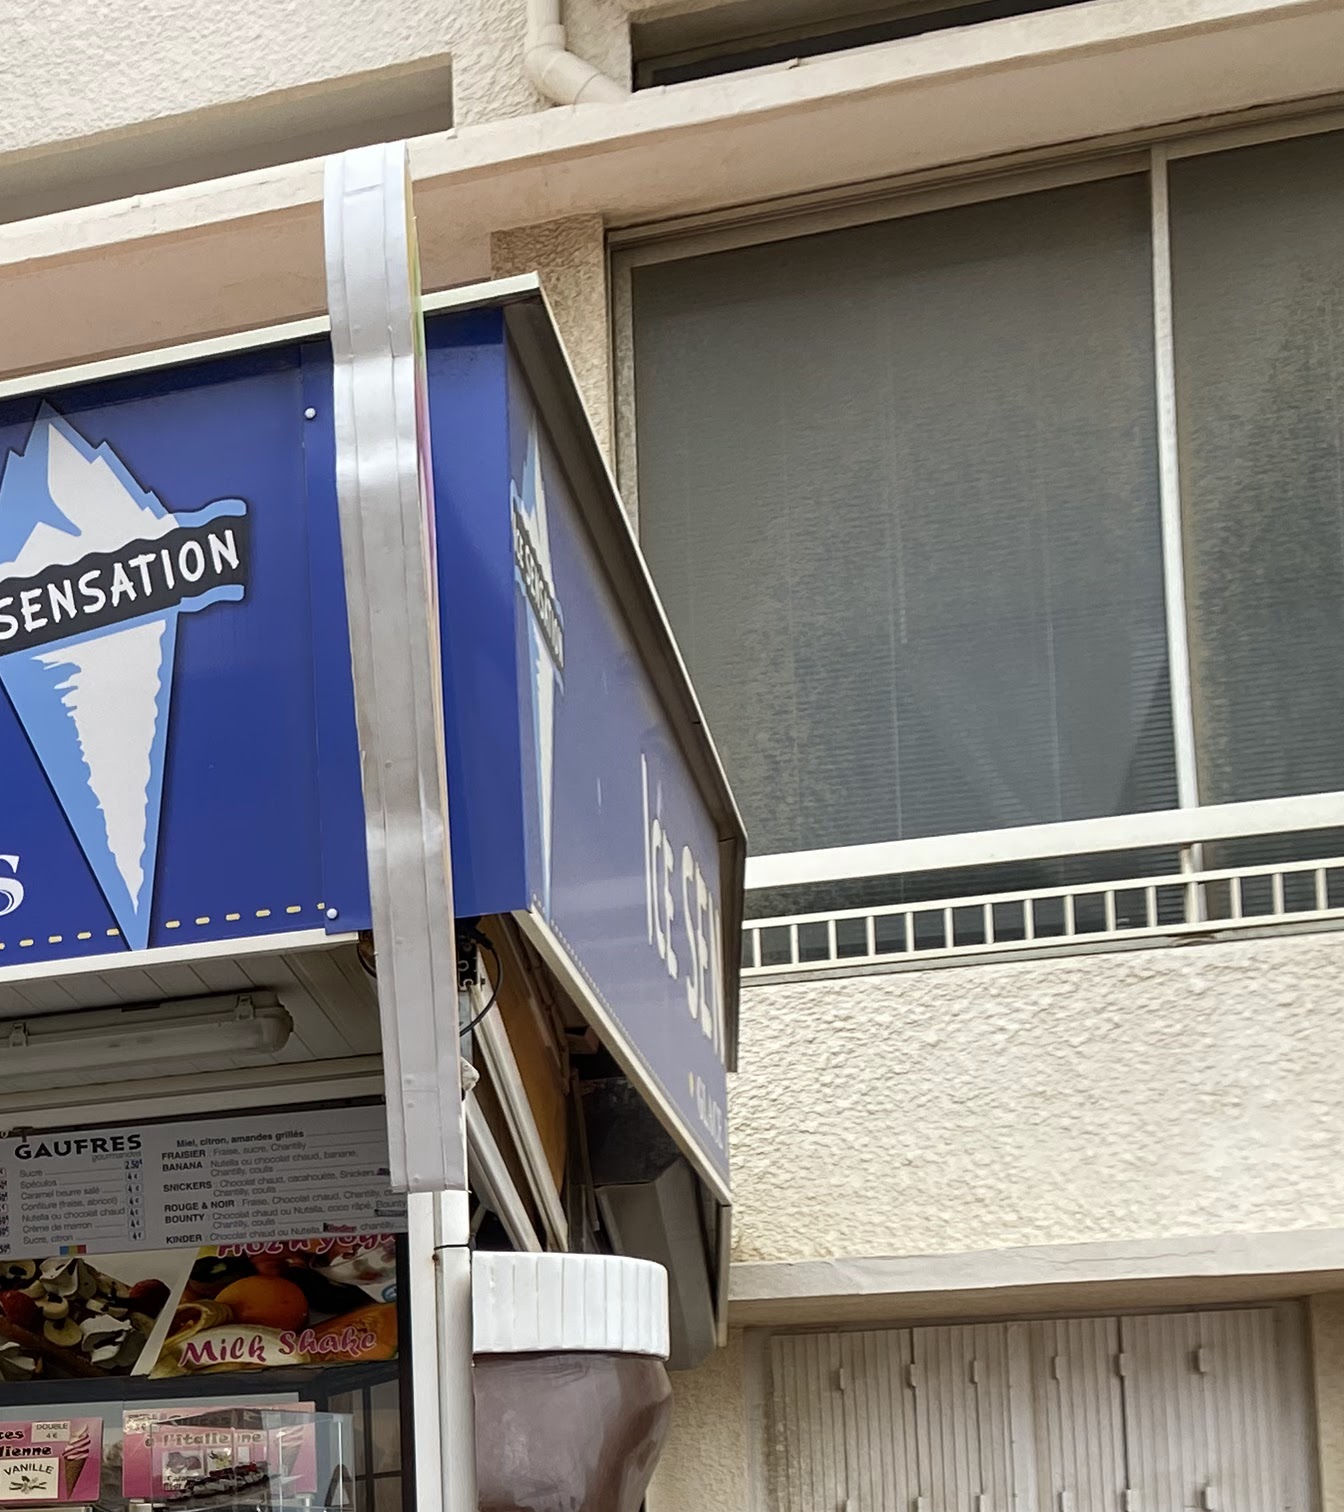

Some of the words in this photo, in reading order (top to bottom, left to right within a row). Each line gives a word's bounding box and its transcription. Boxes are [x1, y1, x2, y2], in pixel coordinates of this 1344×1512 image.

[15, 1134, 141, 1160] GAUFRES
[162, 1150, 206, 1160] FRAISIER
[162, 1161, 203, 1172] BANANA
[163, 1180, 212, 1193] SNICKERS
[165, 1202, 199, 1213] ROUGE
[211, 1200, 234, 1210] NOIR
[165, 1213, 205, 1224] BOUNTY
[166, 1234, 202, 1244] KINDER
[178, 1338, 266, 1368] Milk
[276, 1324, 379, 1360] Shake
[3, 1463, 54, 1476] VANILLE
